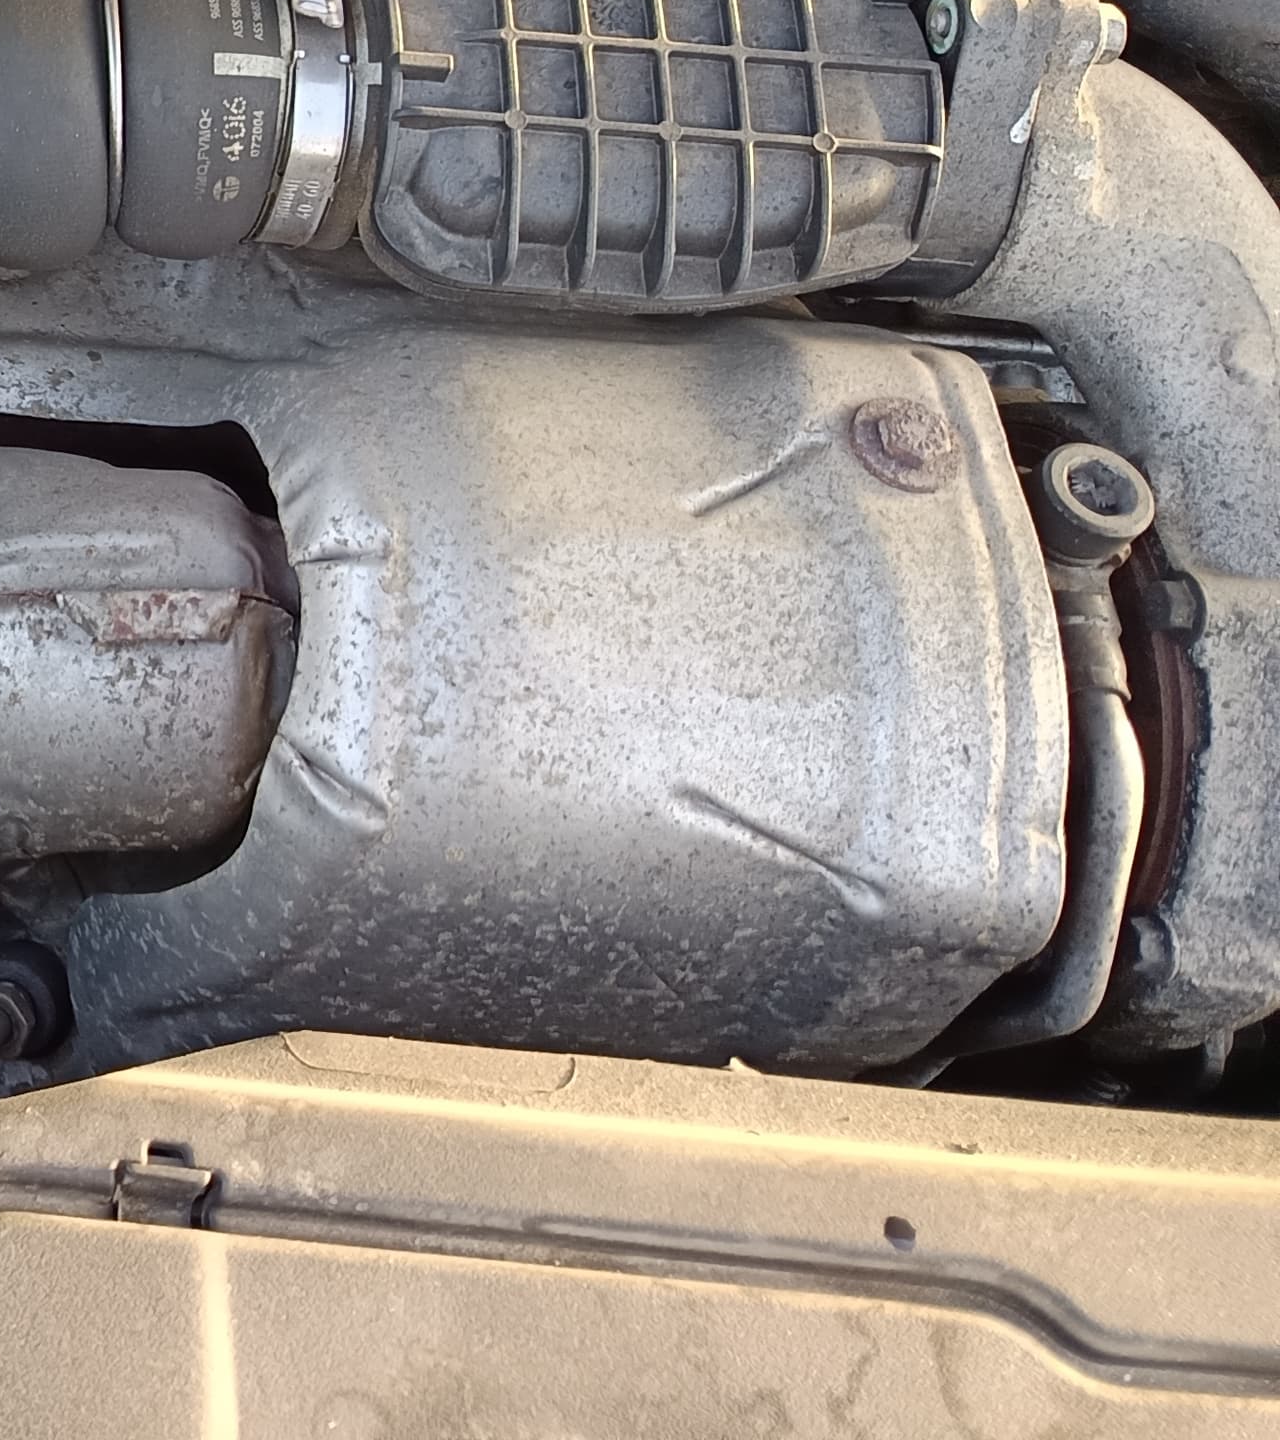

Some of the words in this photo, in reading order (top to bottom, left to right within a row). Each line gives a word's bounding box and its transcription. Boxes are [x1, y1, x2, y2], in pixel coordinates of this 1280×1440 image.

[232, 19, 244, 39] ASS
[253, 21, 265, 41] ASS
[250, 109, 265, 158] 072004
